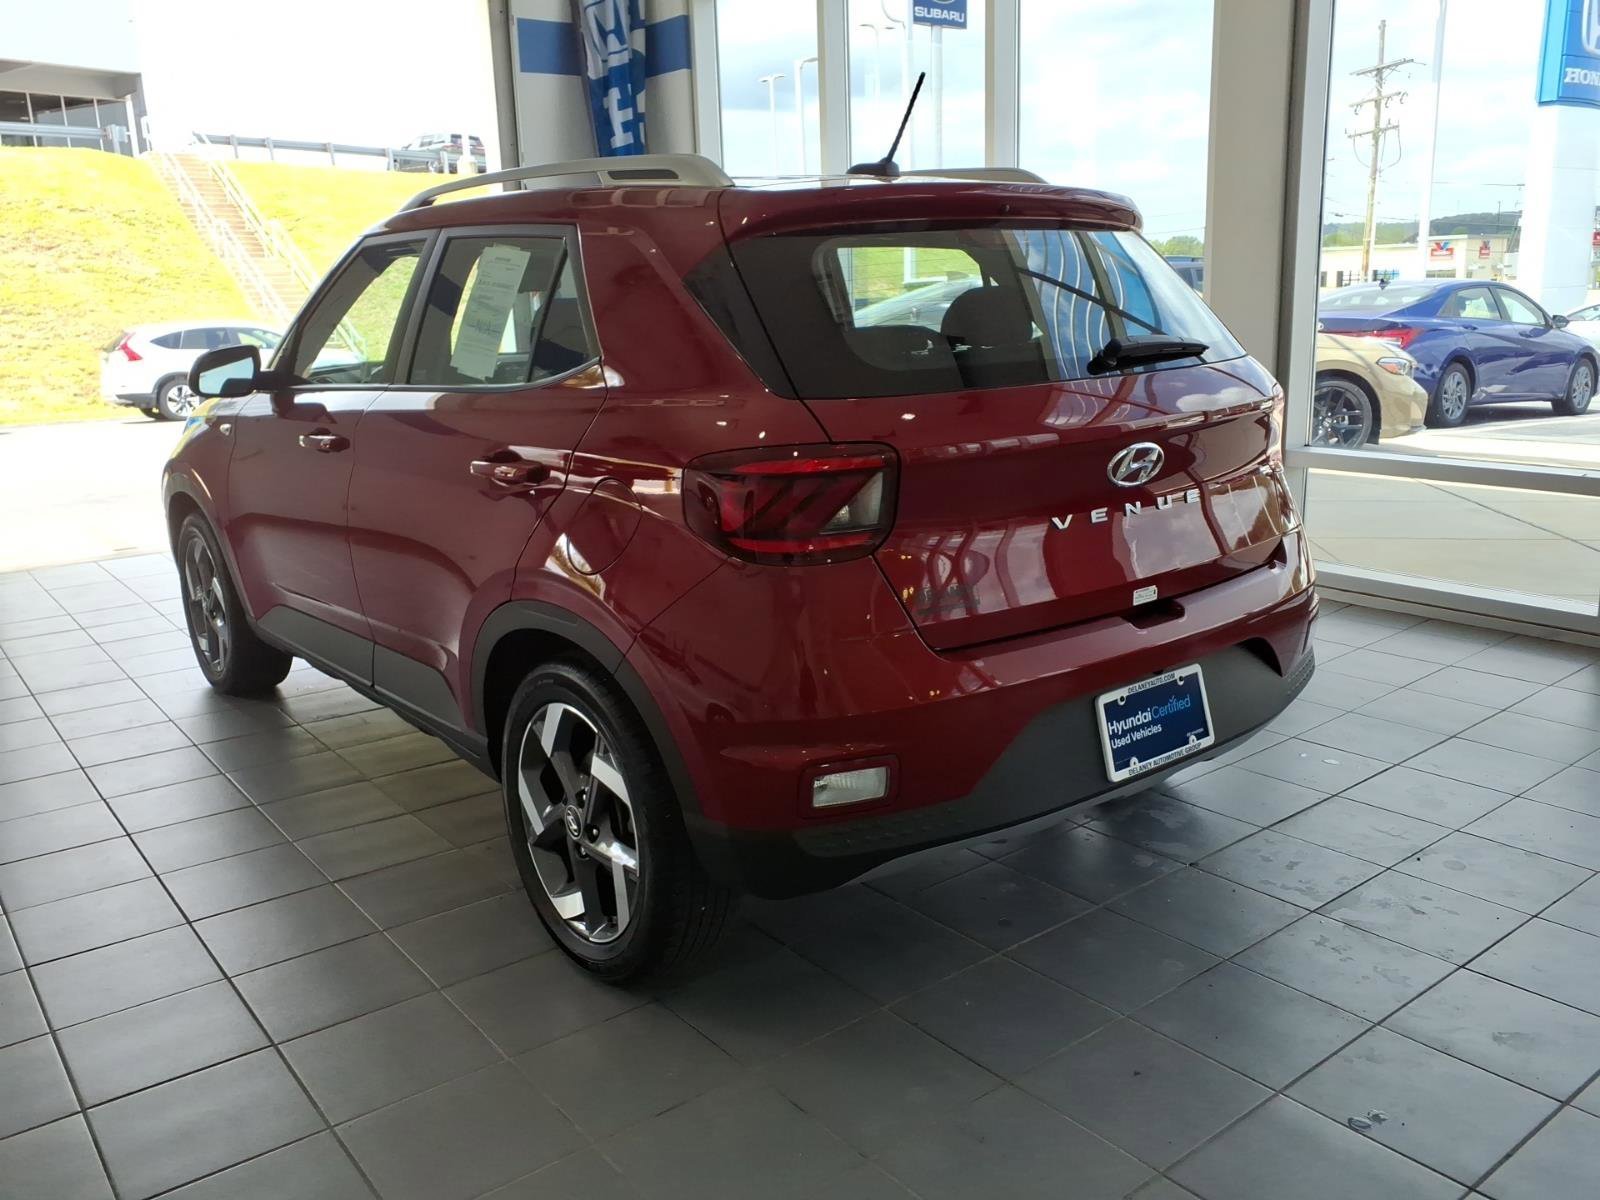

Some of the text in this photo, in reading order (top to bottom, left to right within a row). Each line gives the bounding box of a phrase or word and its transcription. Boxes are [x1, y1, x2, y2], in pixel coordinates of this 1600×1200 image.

[914, 6, 965, 22] SUBARU
[1051, 488, 1201, 530] VENUE
[1128, 673, 1175, 693] DELANEYAUTO.COM
[1108, 694, 1191, 735] Hyundai Certified
[1111, 723, 1162, 749] Used Vehicles
[1128, 761, 1152, 775] DELANEY
[1153, 749, 1184, 766] AUTOMOTIVE
[1184, 742, 1202, 755] GROUP
